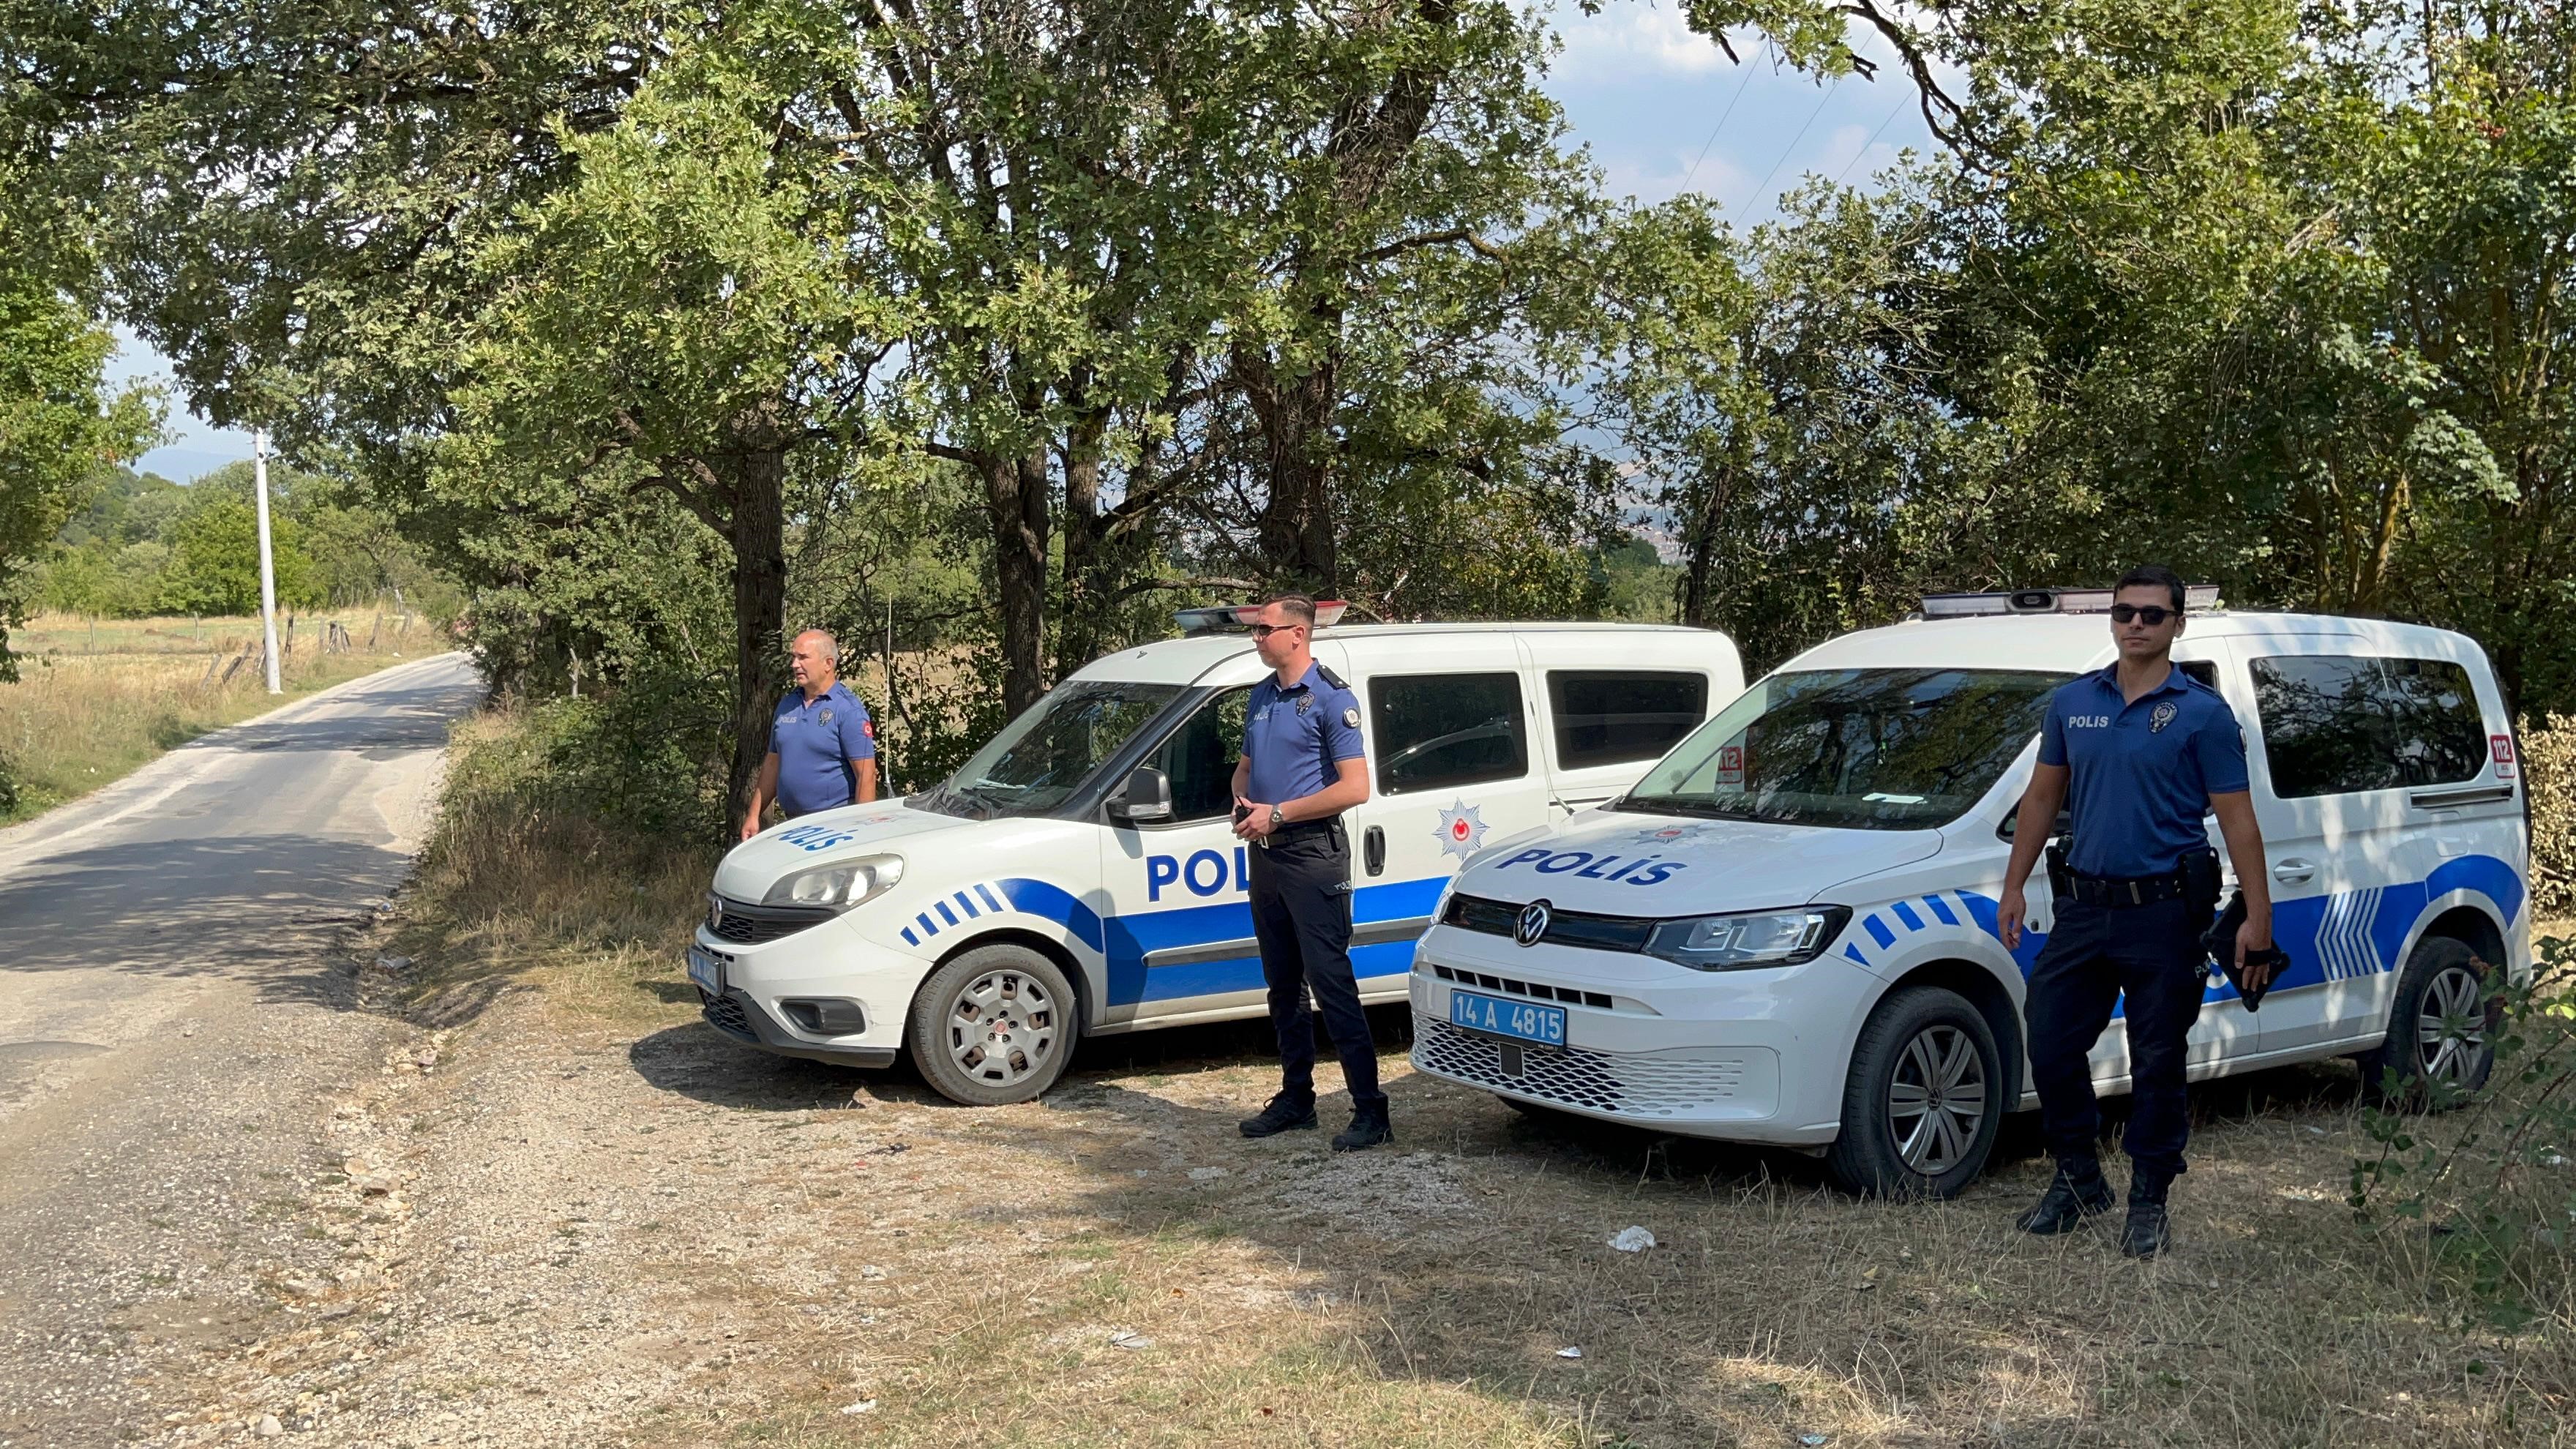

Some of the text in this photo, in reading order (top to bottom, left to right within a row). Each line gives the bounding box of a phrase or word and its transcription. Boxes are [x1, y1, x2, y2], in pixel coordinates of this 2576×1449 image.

[2068, 716, 2109, 728] POLIS
[1720, 750, 1738, 768] 112
[2493, 740, 2511, 760] 112
[1147, 847, 1249, 902] POL
[1494, 849, 1688, 886] POLİS
[1457, 996, 1560, 1040] 14 A 4815
